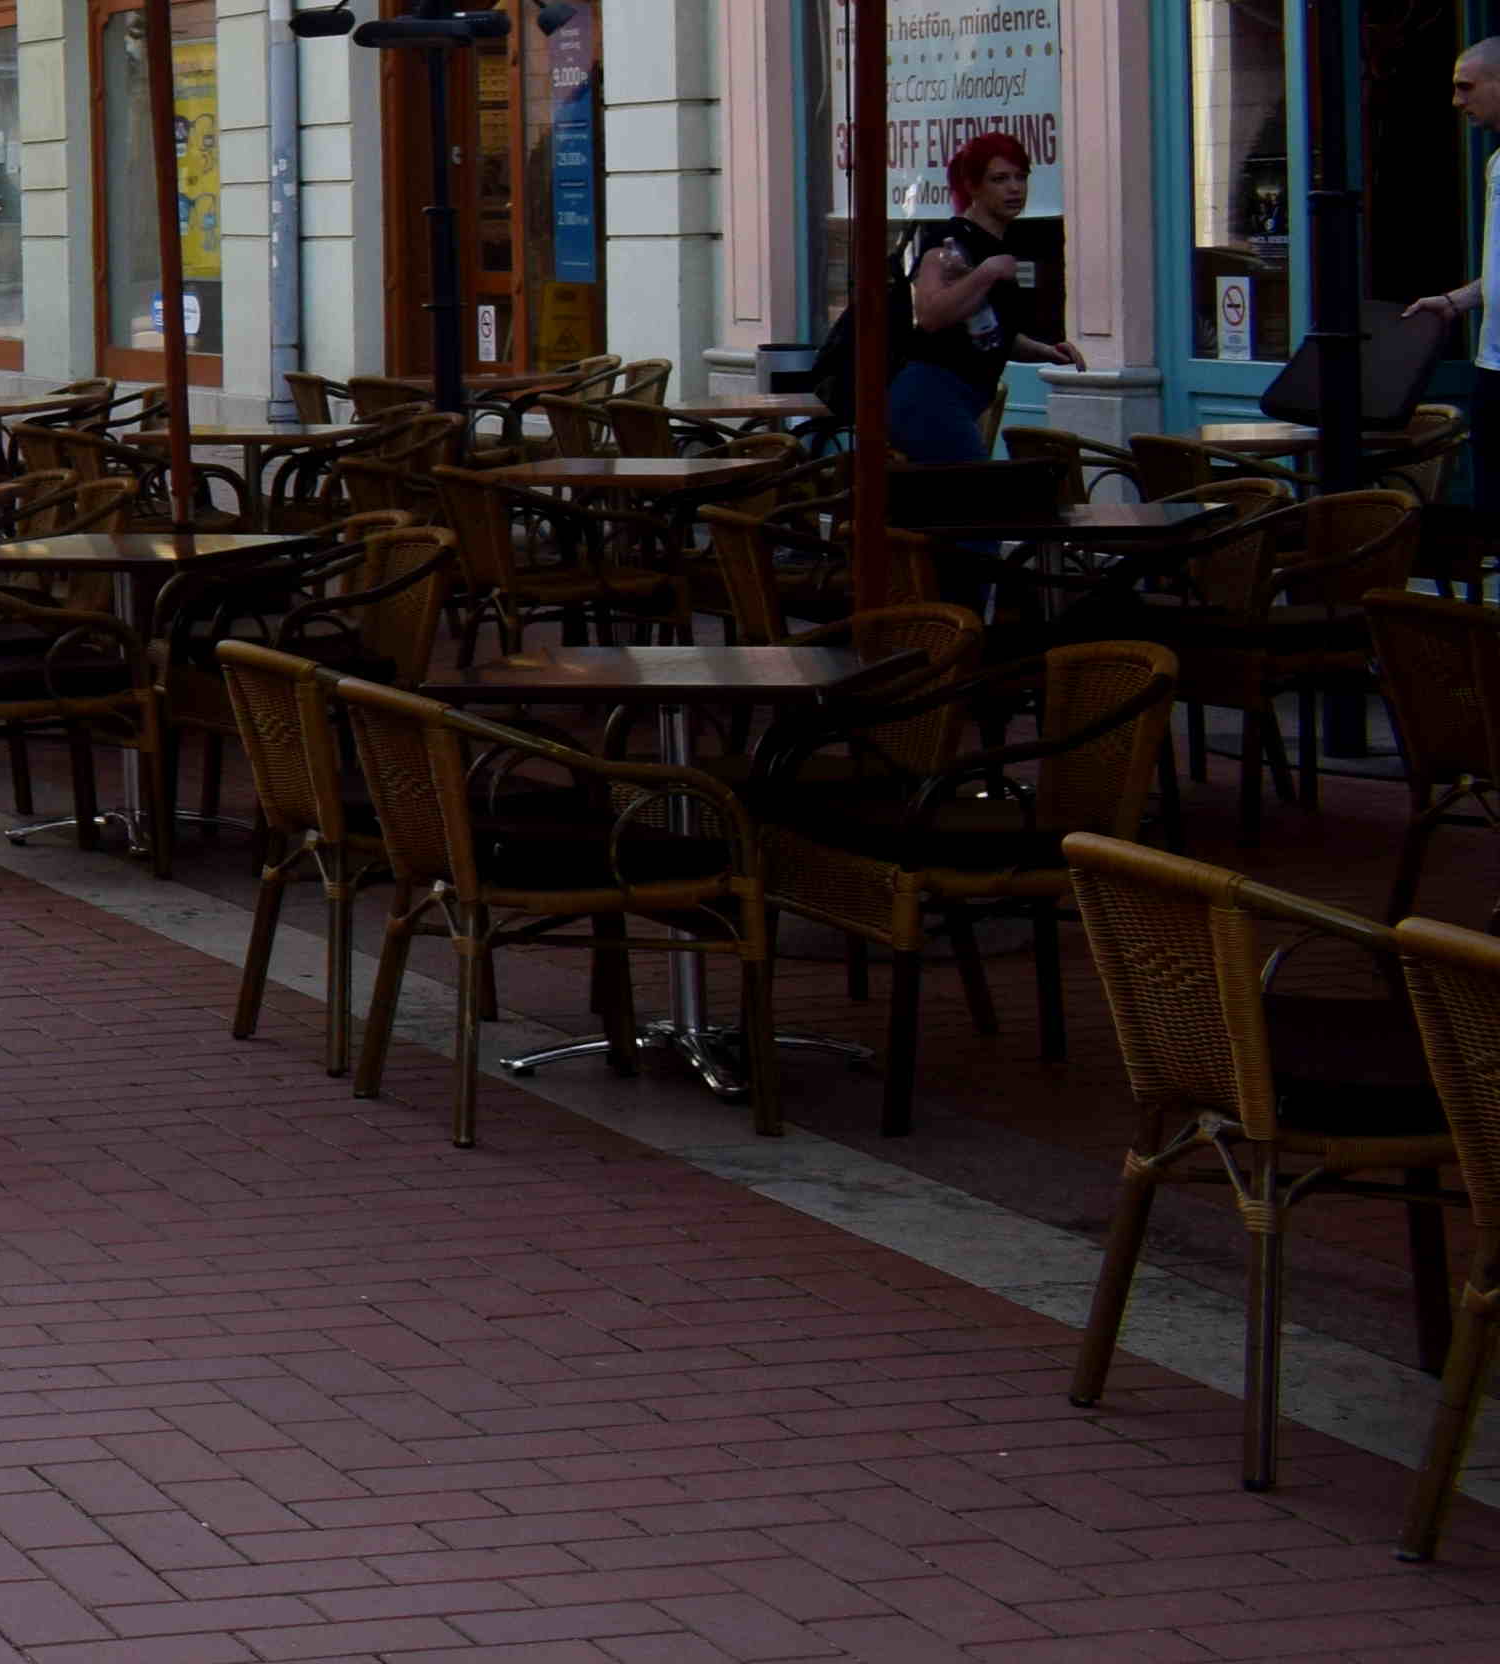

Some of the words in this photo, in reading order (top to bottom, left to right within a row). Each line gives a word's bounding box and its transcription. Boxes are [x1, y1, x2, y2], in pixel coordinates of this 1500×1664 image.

[900, 12, 954, 41] hétfőn,
[959, 5, 1052, 40] mindenre.
[906, 74, 946, 103] Corso
[953, 68, 1026, 105] Mondays!
[887, 119, 920, 168] OFF
[927, 112, 1057, 168] EVEING
